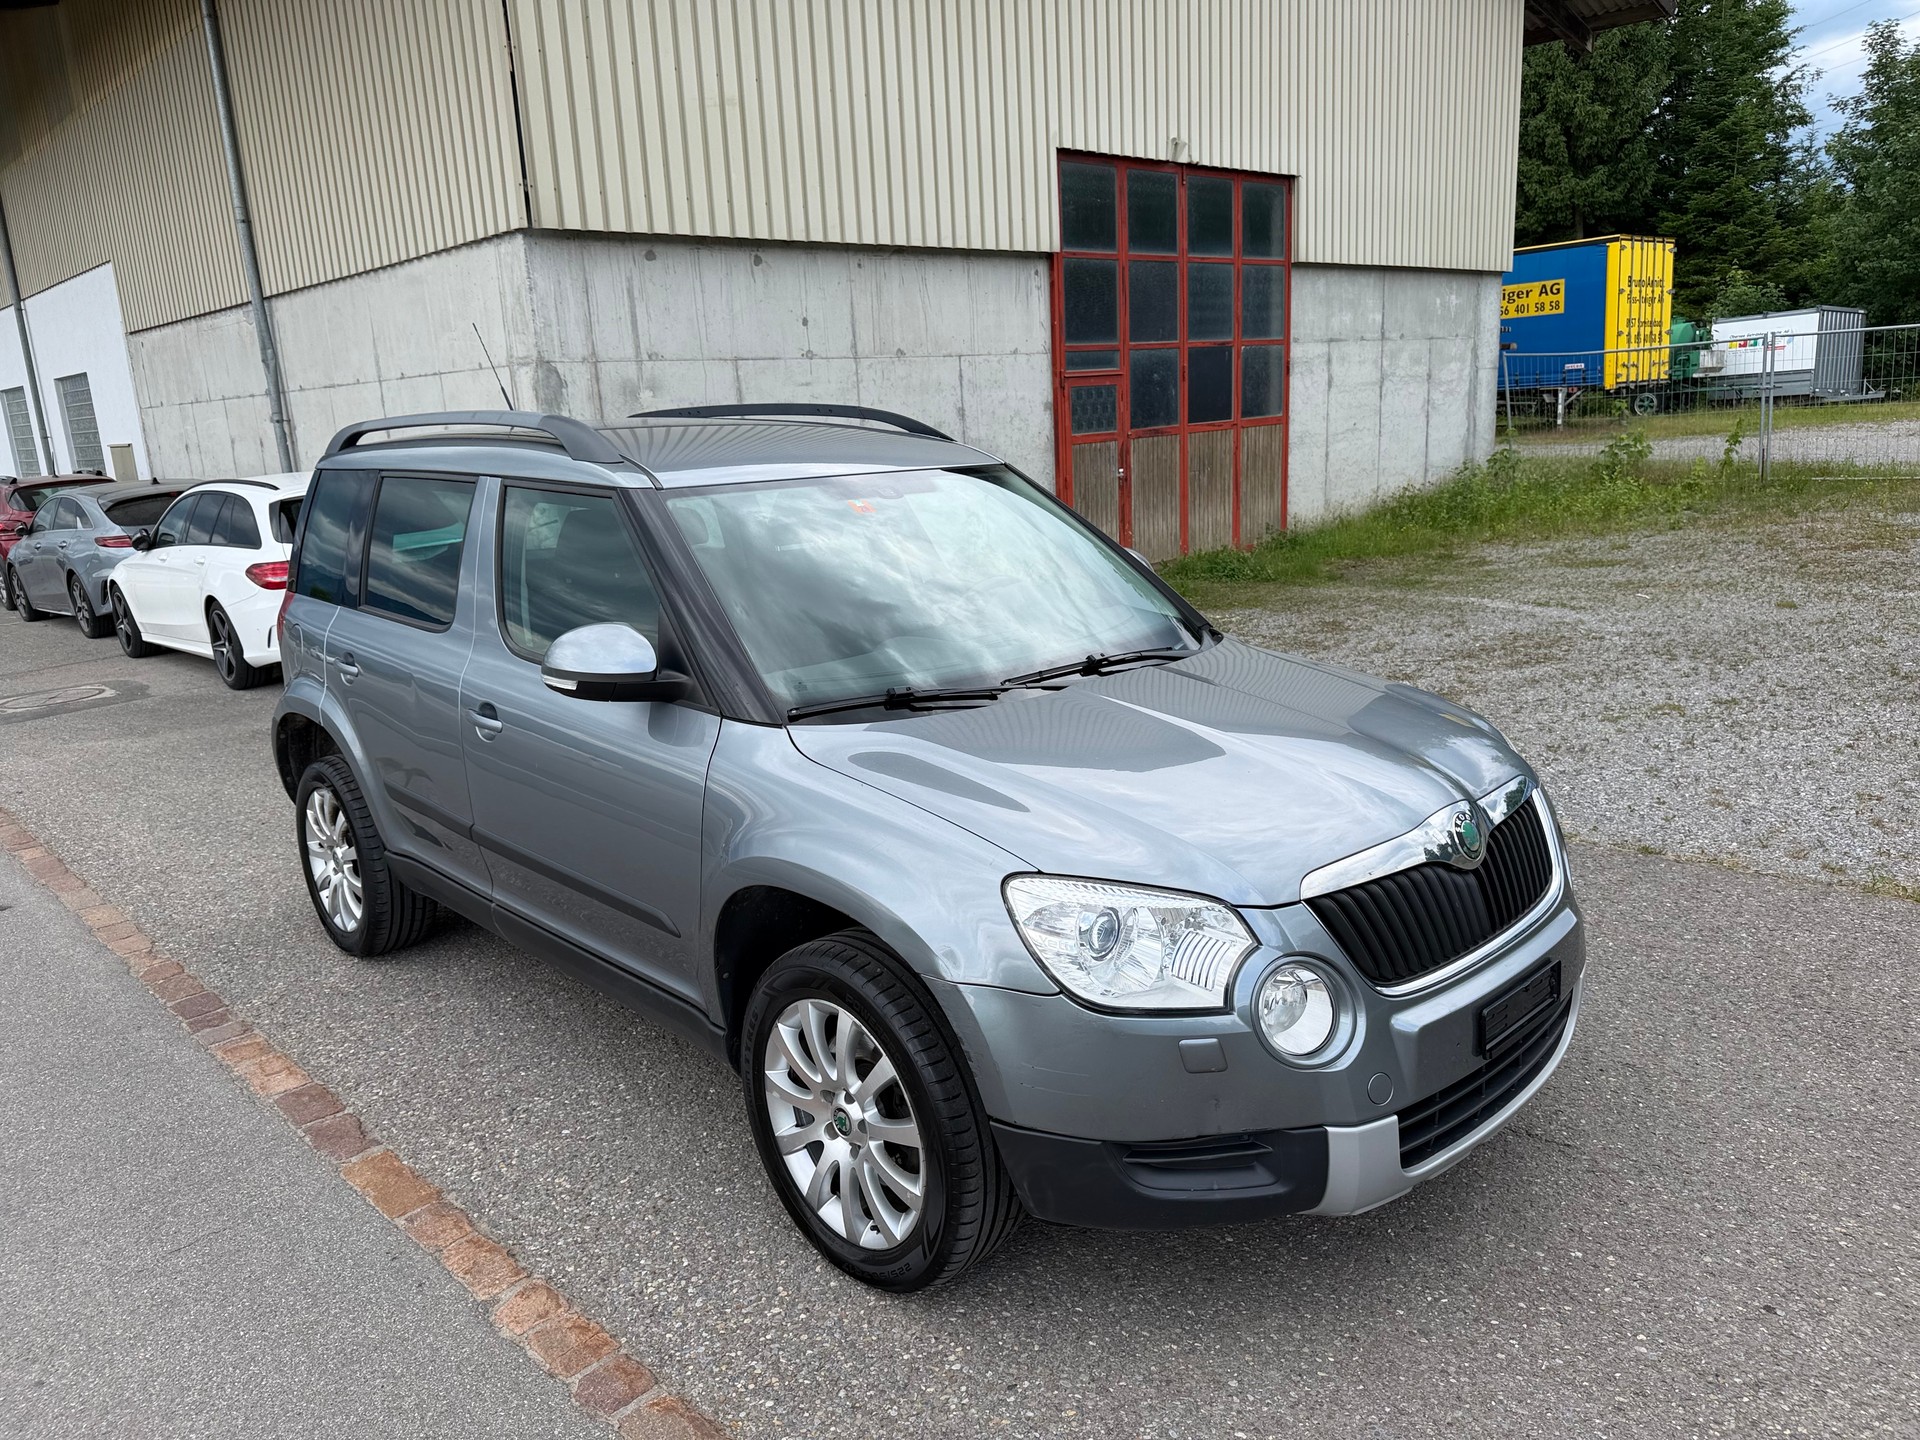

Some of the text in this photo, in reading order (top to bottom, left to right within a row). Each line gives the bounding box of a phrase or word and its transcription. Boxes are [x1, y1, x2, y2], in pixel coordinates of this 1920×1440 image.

[1538, 282, 1561, 298] AG
[1514, 303, 1530, 315] 401
[1534, 301, 1546, 313] 58
[1549, 299, 1561, 312] 58
